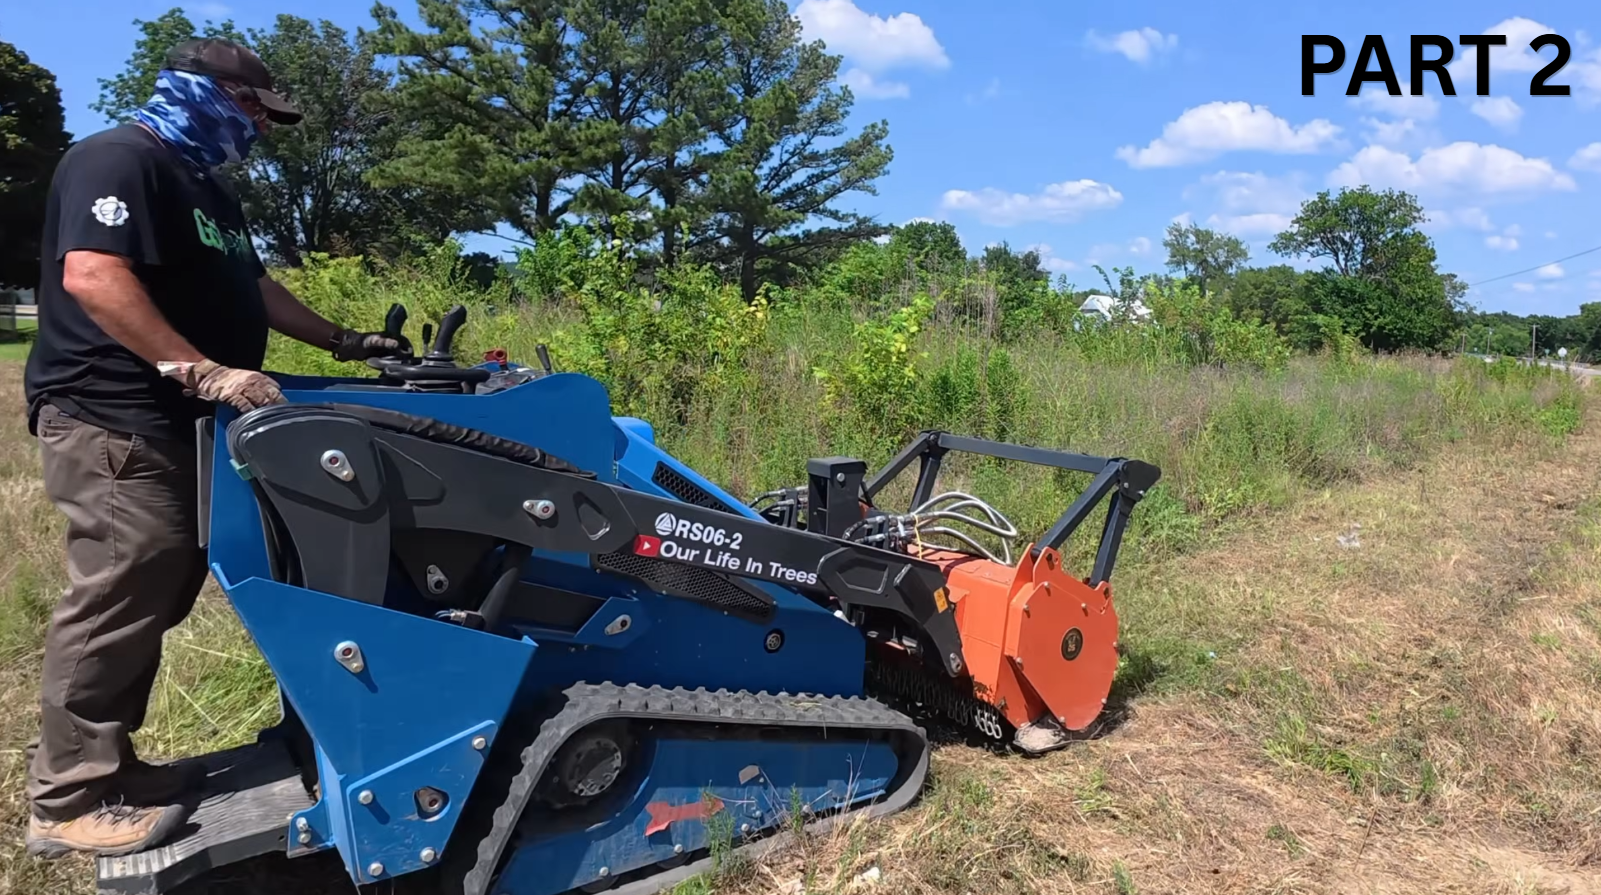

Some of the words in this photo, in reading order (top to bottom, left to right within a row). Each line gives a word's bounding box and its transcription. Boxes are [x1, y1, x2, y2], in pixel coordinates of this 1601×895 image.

[674, 519, 743, 550] RS06-2
[660, 541, 699, 562] Our
[704, 549, 741, 570] Life
[745, 557, 762, 575] In
[769, 561, 818, 585] Trees
